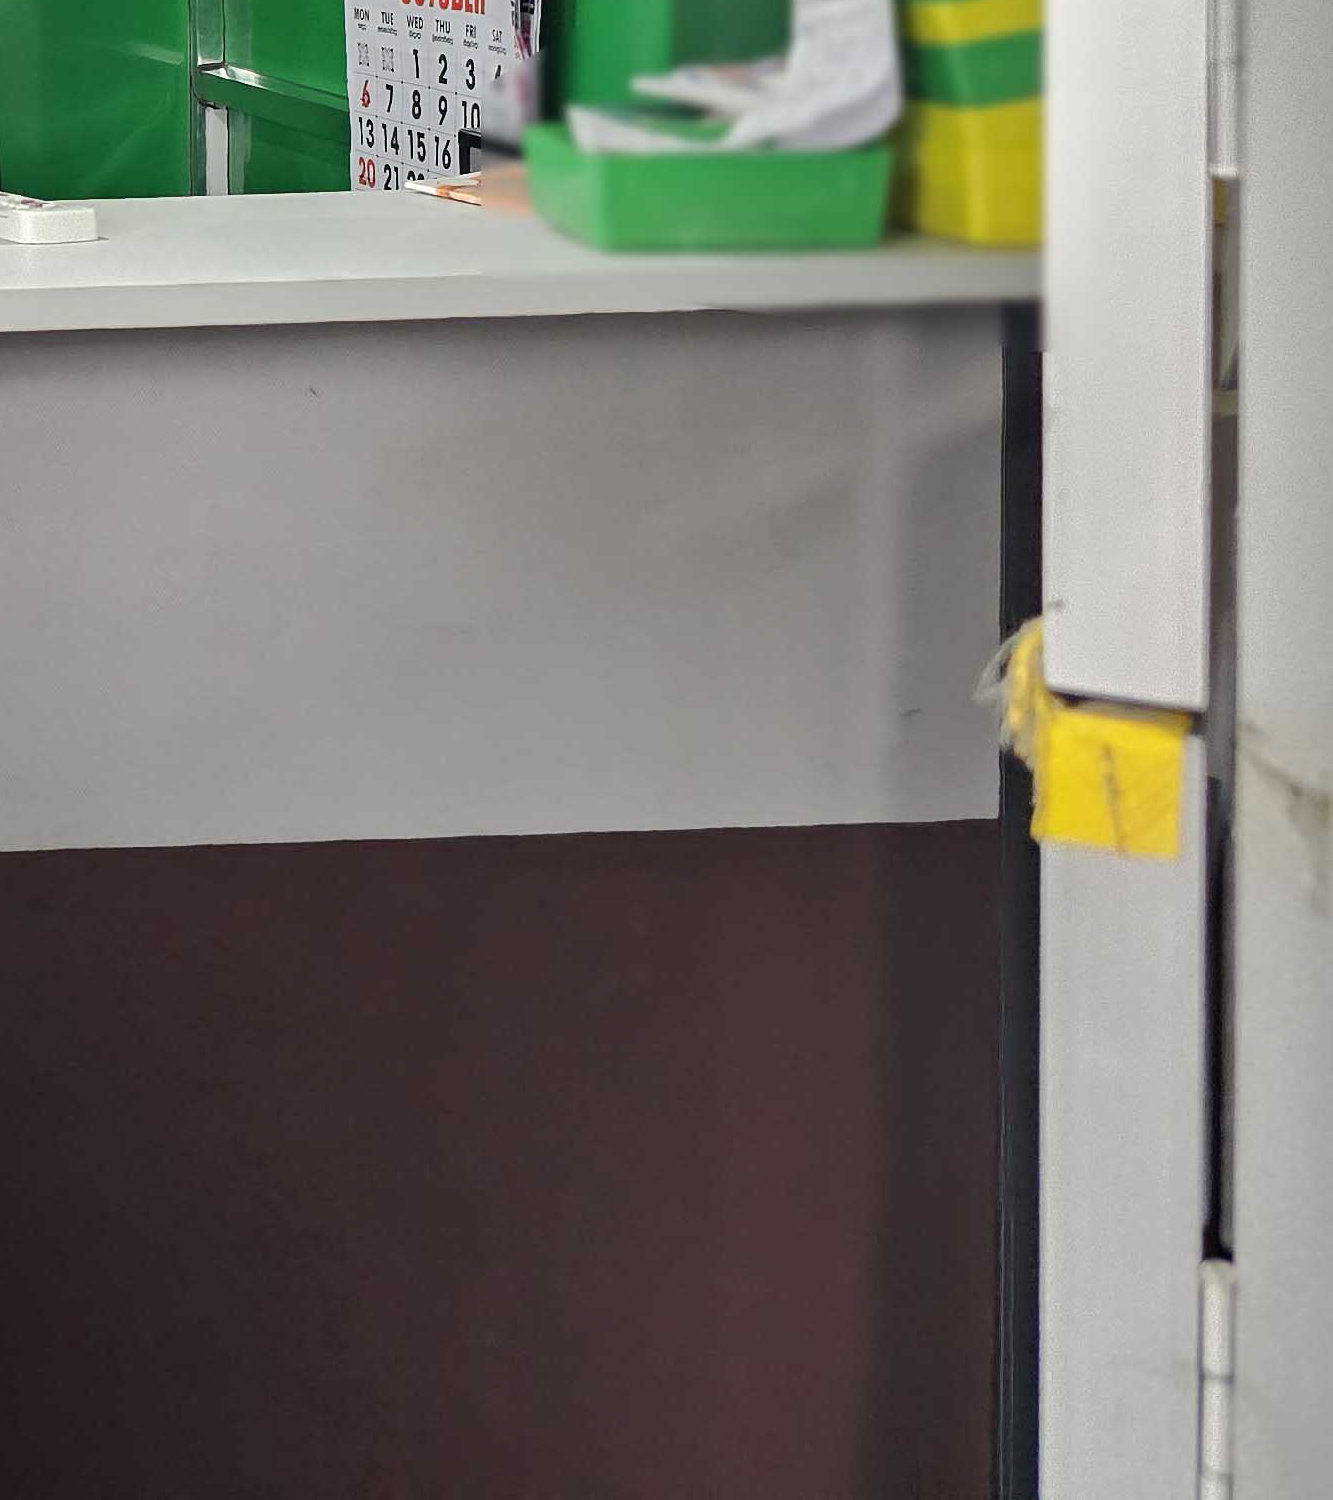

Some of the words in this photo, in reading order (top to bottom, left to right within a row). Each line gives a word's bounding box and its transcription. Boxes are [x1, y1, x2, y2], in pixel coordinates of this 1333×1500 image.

[354, 8, 369, 22] MON
[381, 12, 394, 26] TUE
[407, 15, 423, 30] WED
[436, 19, 451, 34] THU
[466, 25, 477, 39] FRI
[492, 29, 503, 44] SAT
[412, 50, 420, 79] 1
[438, 53, 447, 84] 2
[465, 58, 475, 90] 3
[360, 80, 371, 108] 6
[385, 84, 393, 112] 7
[412, 90, 421, 119] 8
[438, 96, 447, 125] 9
[462, 101, 480, 128] 10
[359, 117, 374, 148] 13
[382, 123, 399, 155] 14
[408, 130, 426, 162] 15
[435, 136, 451, 169] 16
[359, 157, 375, 188] 20
[383, 164, 399, 190] 21
